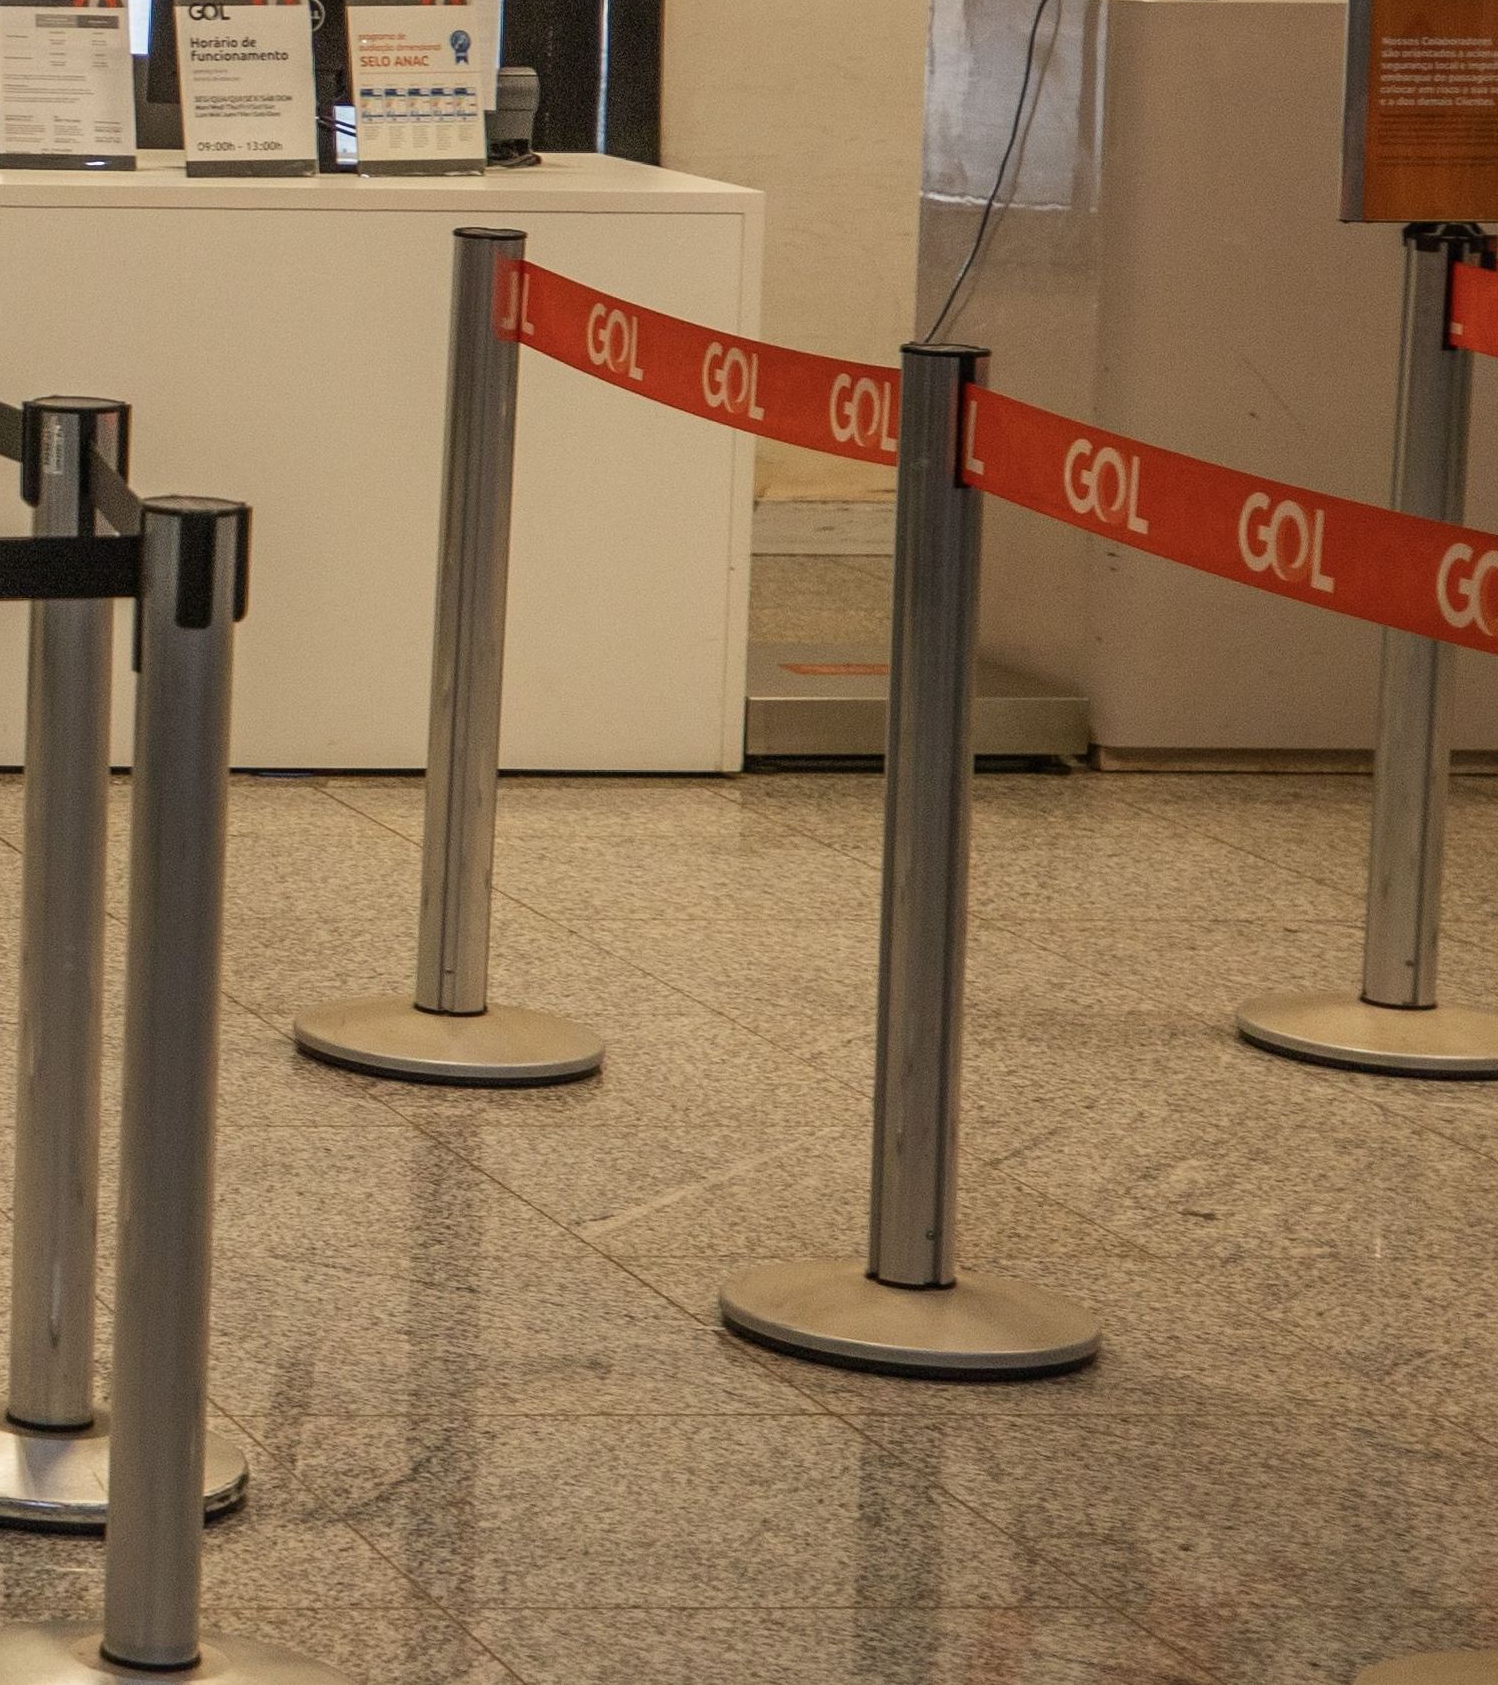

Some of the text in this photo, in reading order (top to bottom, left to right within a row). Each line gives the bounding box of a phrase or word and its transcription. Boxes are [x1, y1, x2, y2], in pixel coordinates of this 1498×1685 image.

[189, 4, 230, 21] GOL
[190, 37, 257, 49] Horário de
[191, 50, 289, 62] funcionamento
[360, 55, 430, 67] SELO ANAC
[587, 302, 644, 381] GOL
[702, 341, 764, 421] GOL
[830, 373, 898, 452] GOL
[1064, 439, 1149, 535] GOL
[1238, 492, 1335, 594] GOL
[1437, 543, 1498, 638] GO
